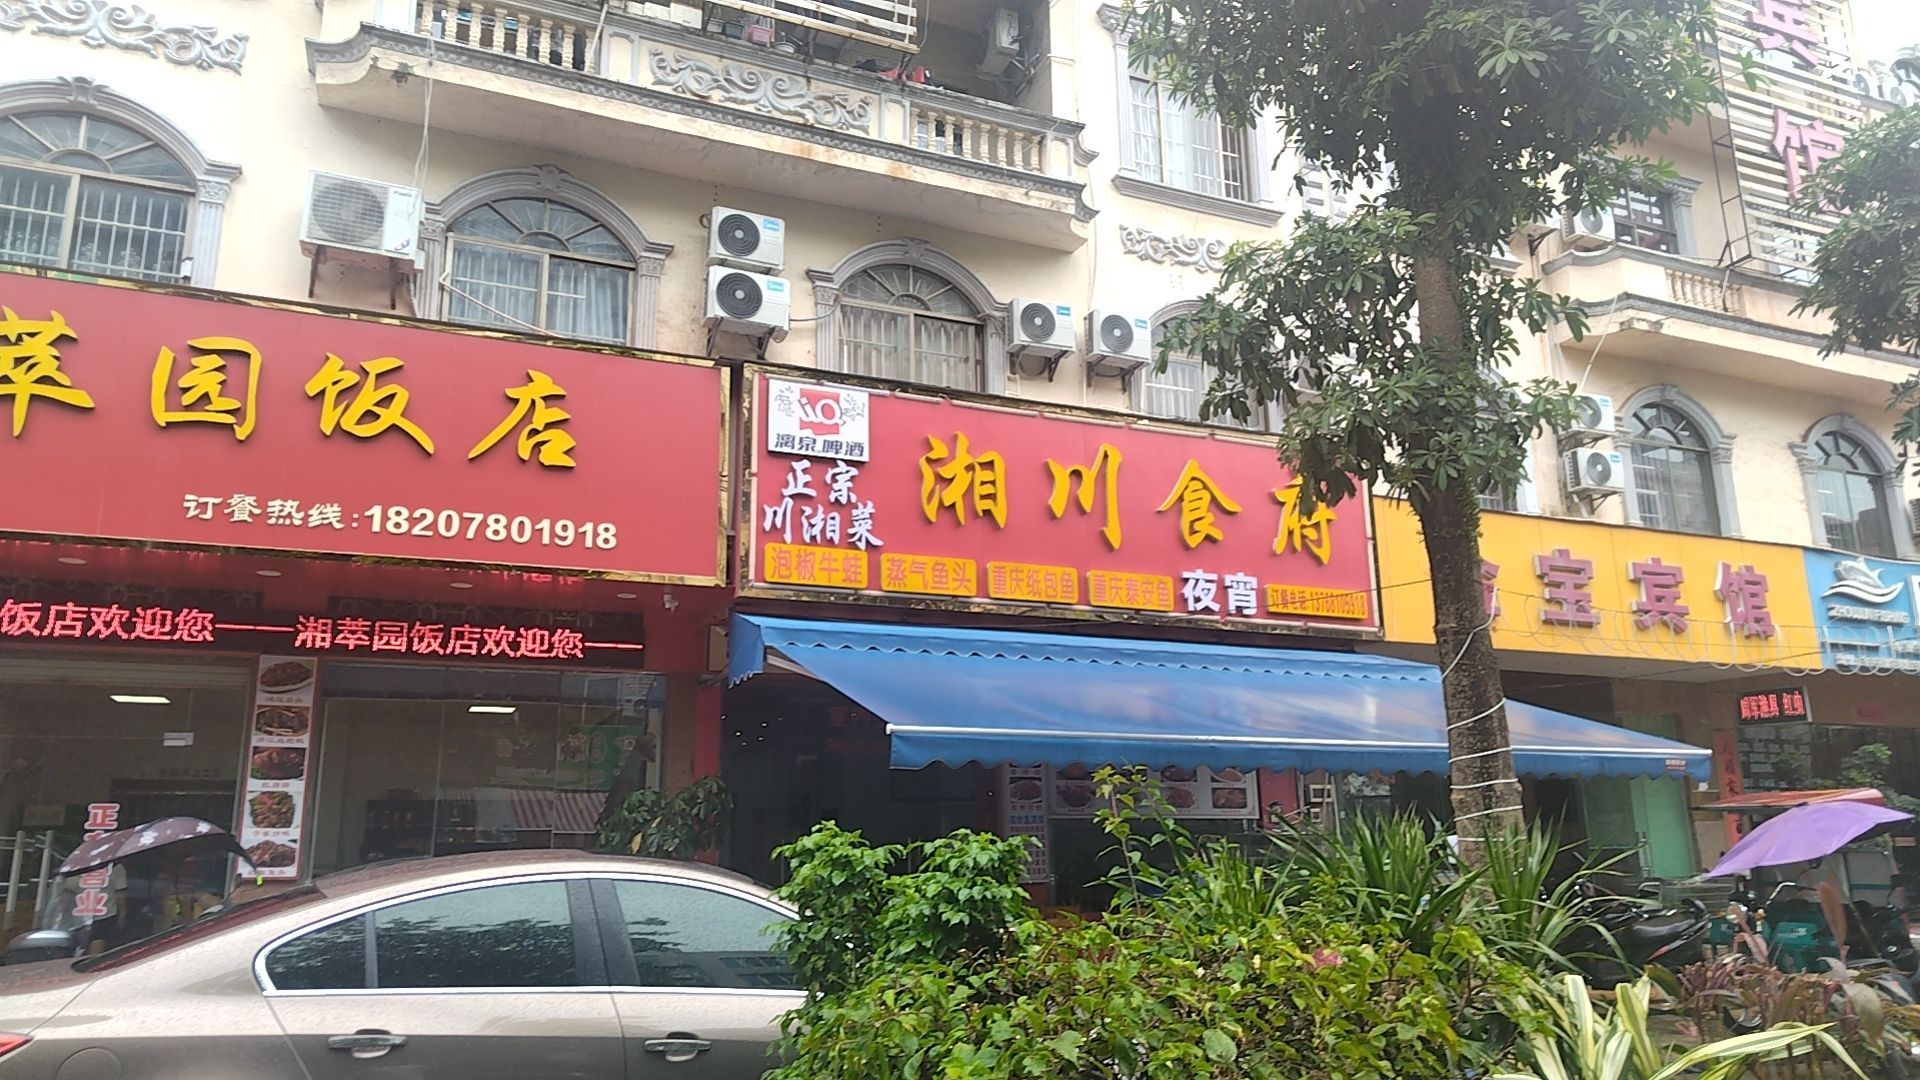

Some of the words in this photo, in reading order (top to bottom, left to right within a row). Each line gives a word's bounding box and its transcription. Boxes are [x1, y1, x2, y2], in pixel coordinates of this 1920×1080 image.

[782, 459, 859, 505] 正宗
[921, 431, 1337, 565] 湘川食府
[763, 497, 884, 551] 川湘菜
[770, 546, 862, 585] 泡椒牛蛙
[886, 556, 972, 593] 蒸气鱼头
[992, 565, 1074, 600] 重庆纸包鱼
[1180, 568, 1258, 615] 夜宵
